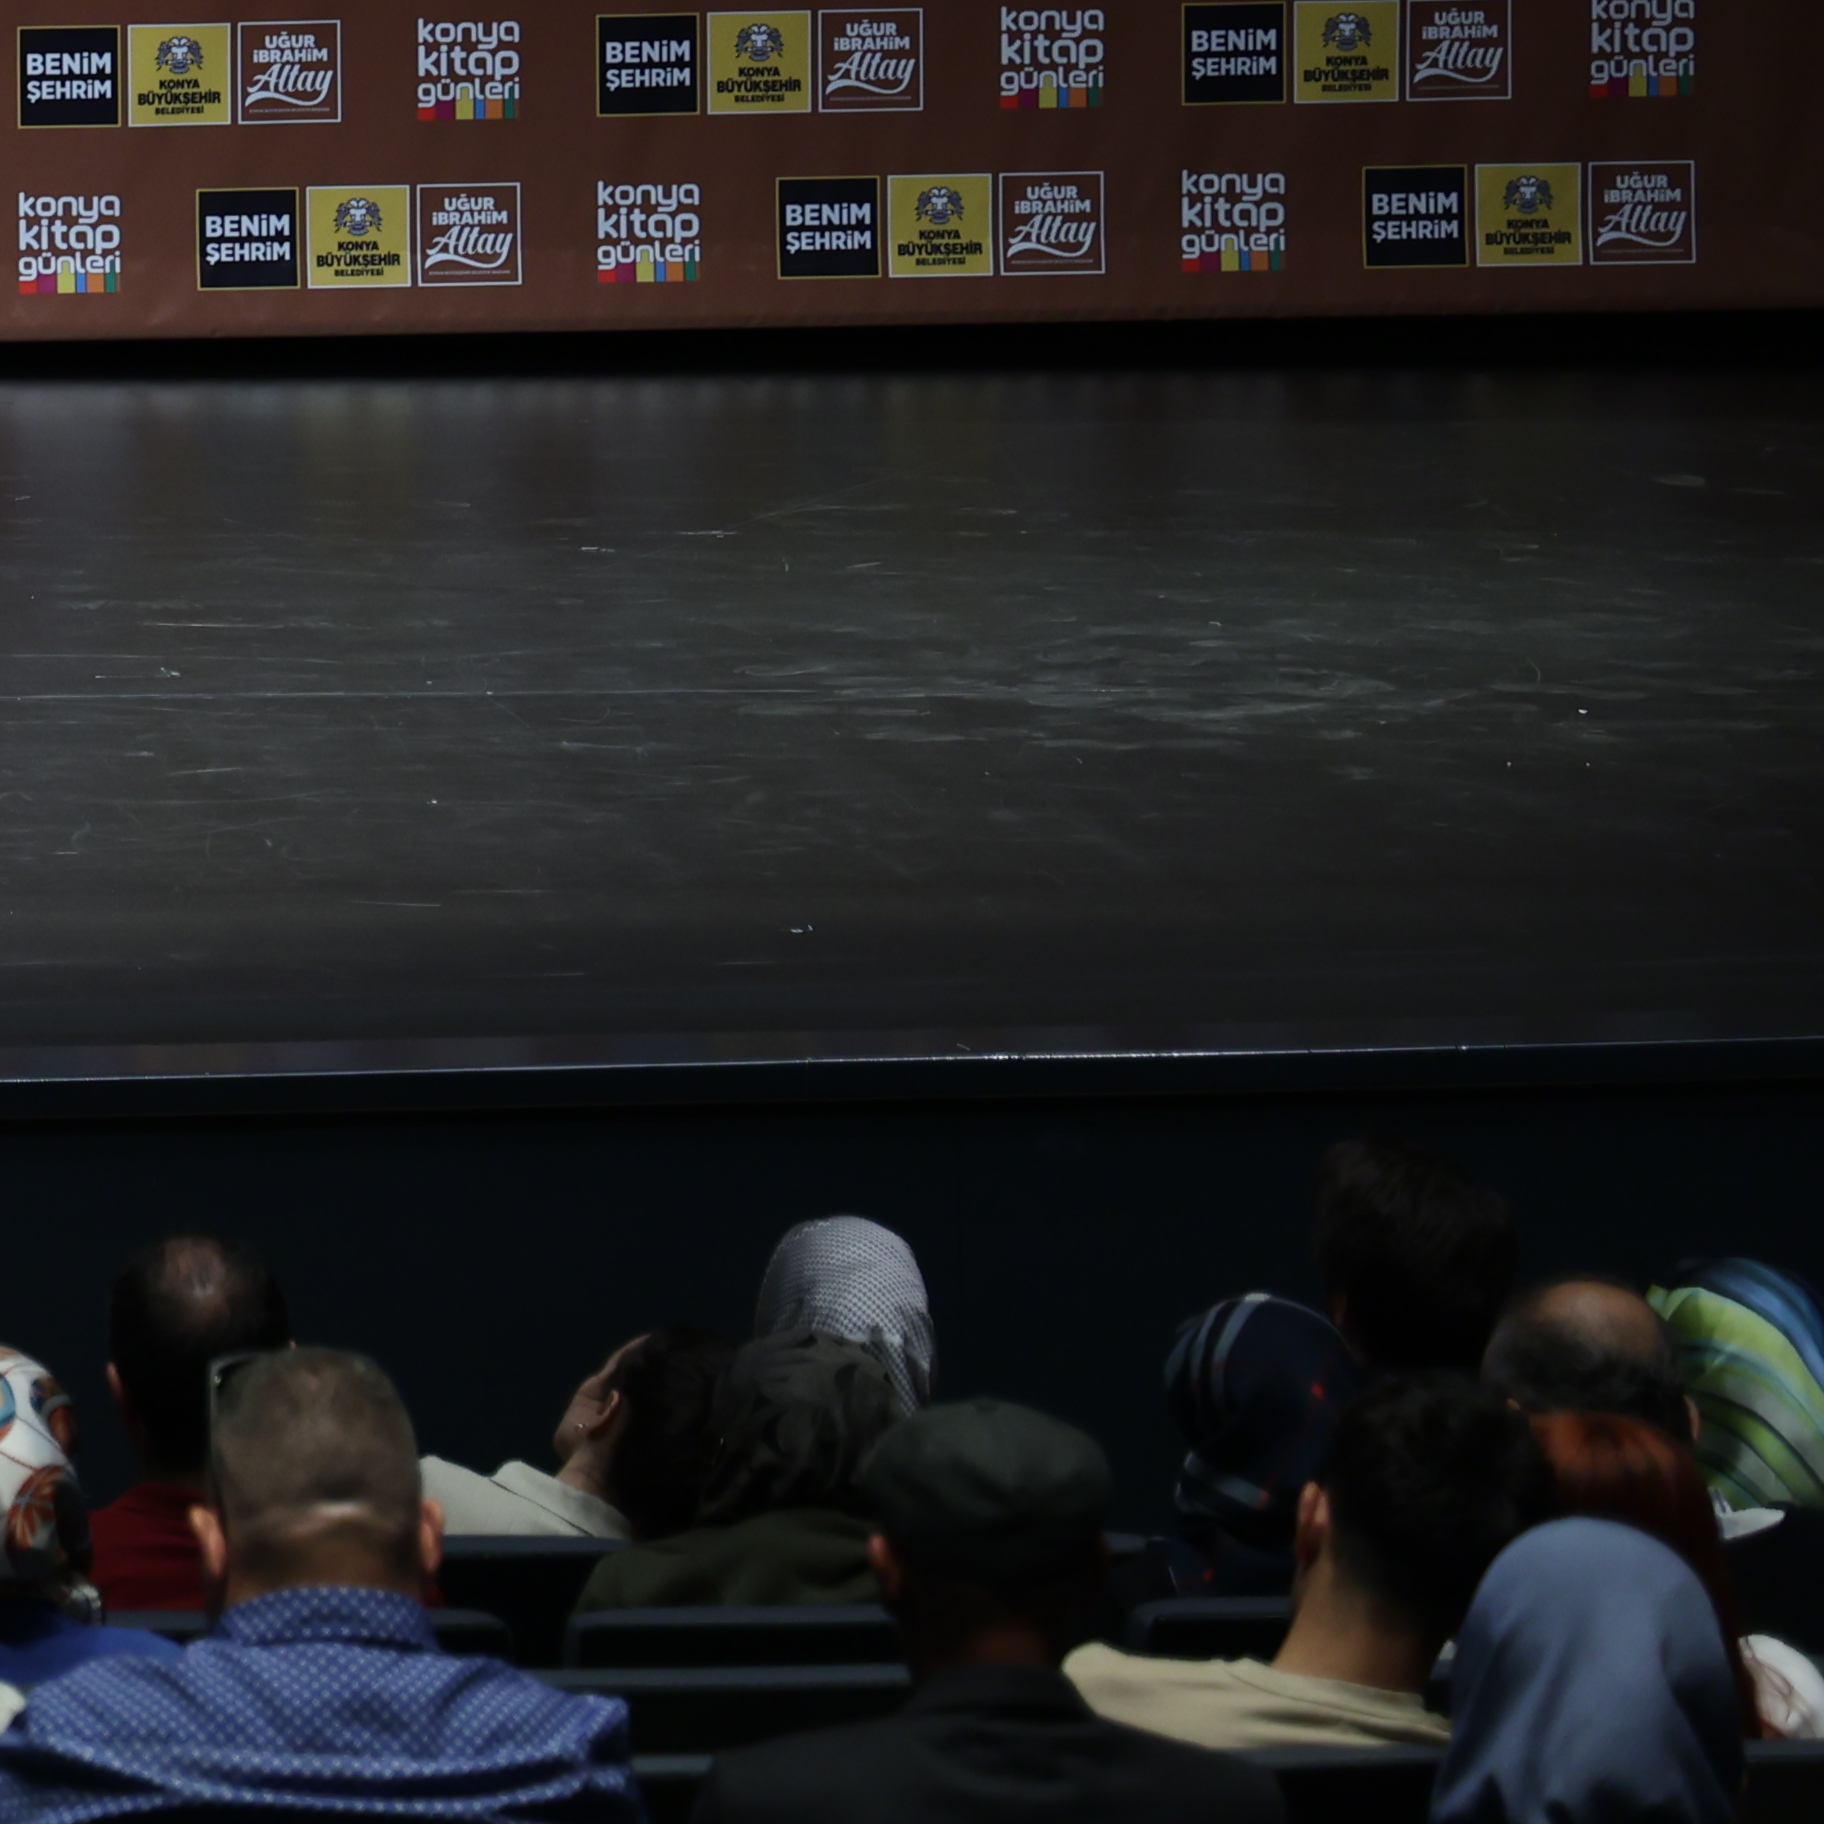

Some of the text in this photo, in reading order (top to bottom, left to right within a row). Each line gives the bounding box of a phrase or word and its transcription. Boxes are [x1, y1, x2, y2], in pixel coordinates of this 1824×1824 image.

[846, 18, 898, 36] UĞUR
[1000, 5, 1105, 38] konya
[1000, 32, 1104, 70] kitap
[825, 50, 916, 95] Altay
[1000, 65, 1104, 96] günleri
[597, 180, 700, 212] konya
[597, 206, 700, 244] kitap
[597, 239, 701, 270] günleri
